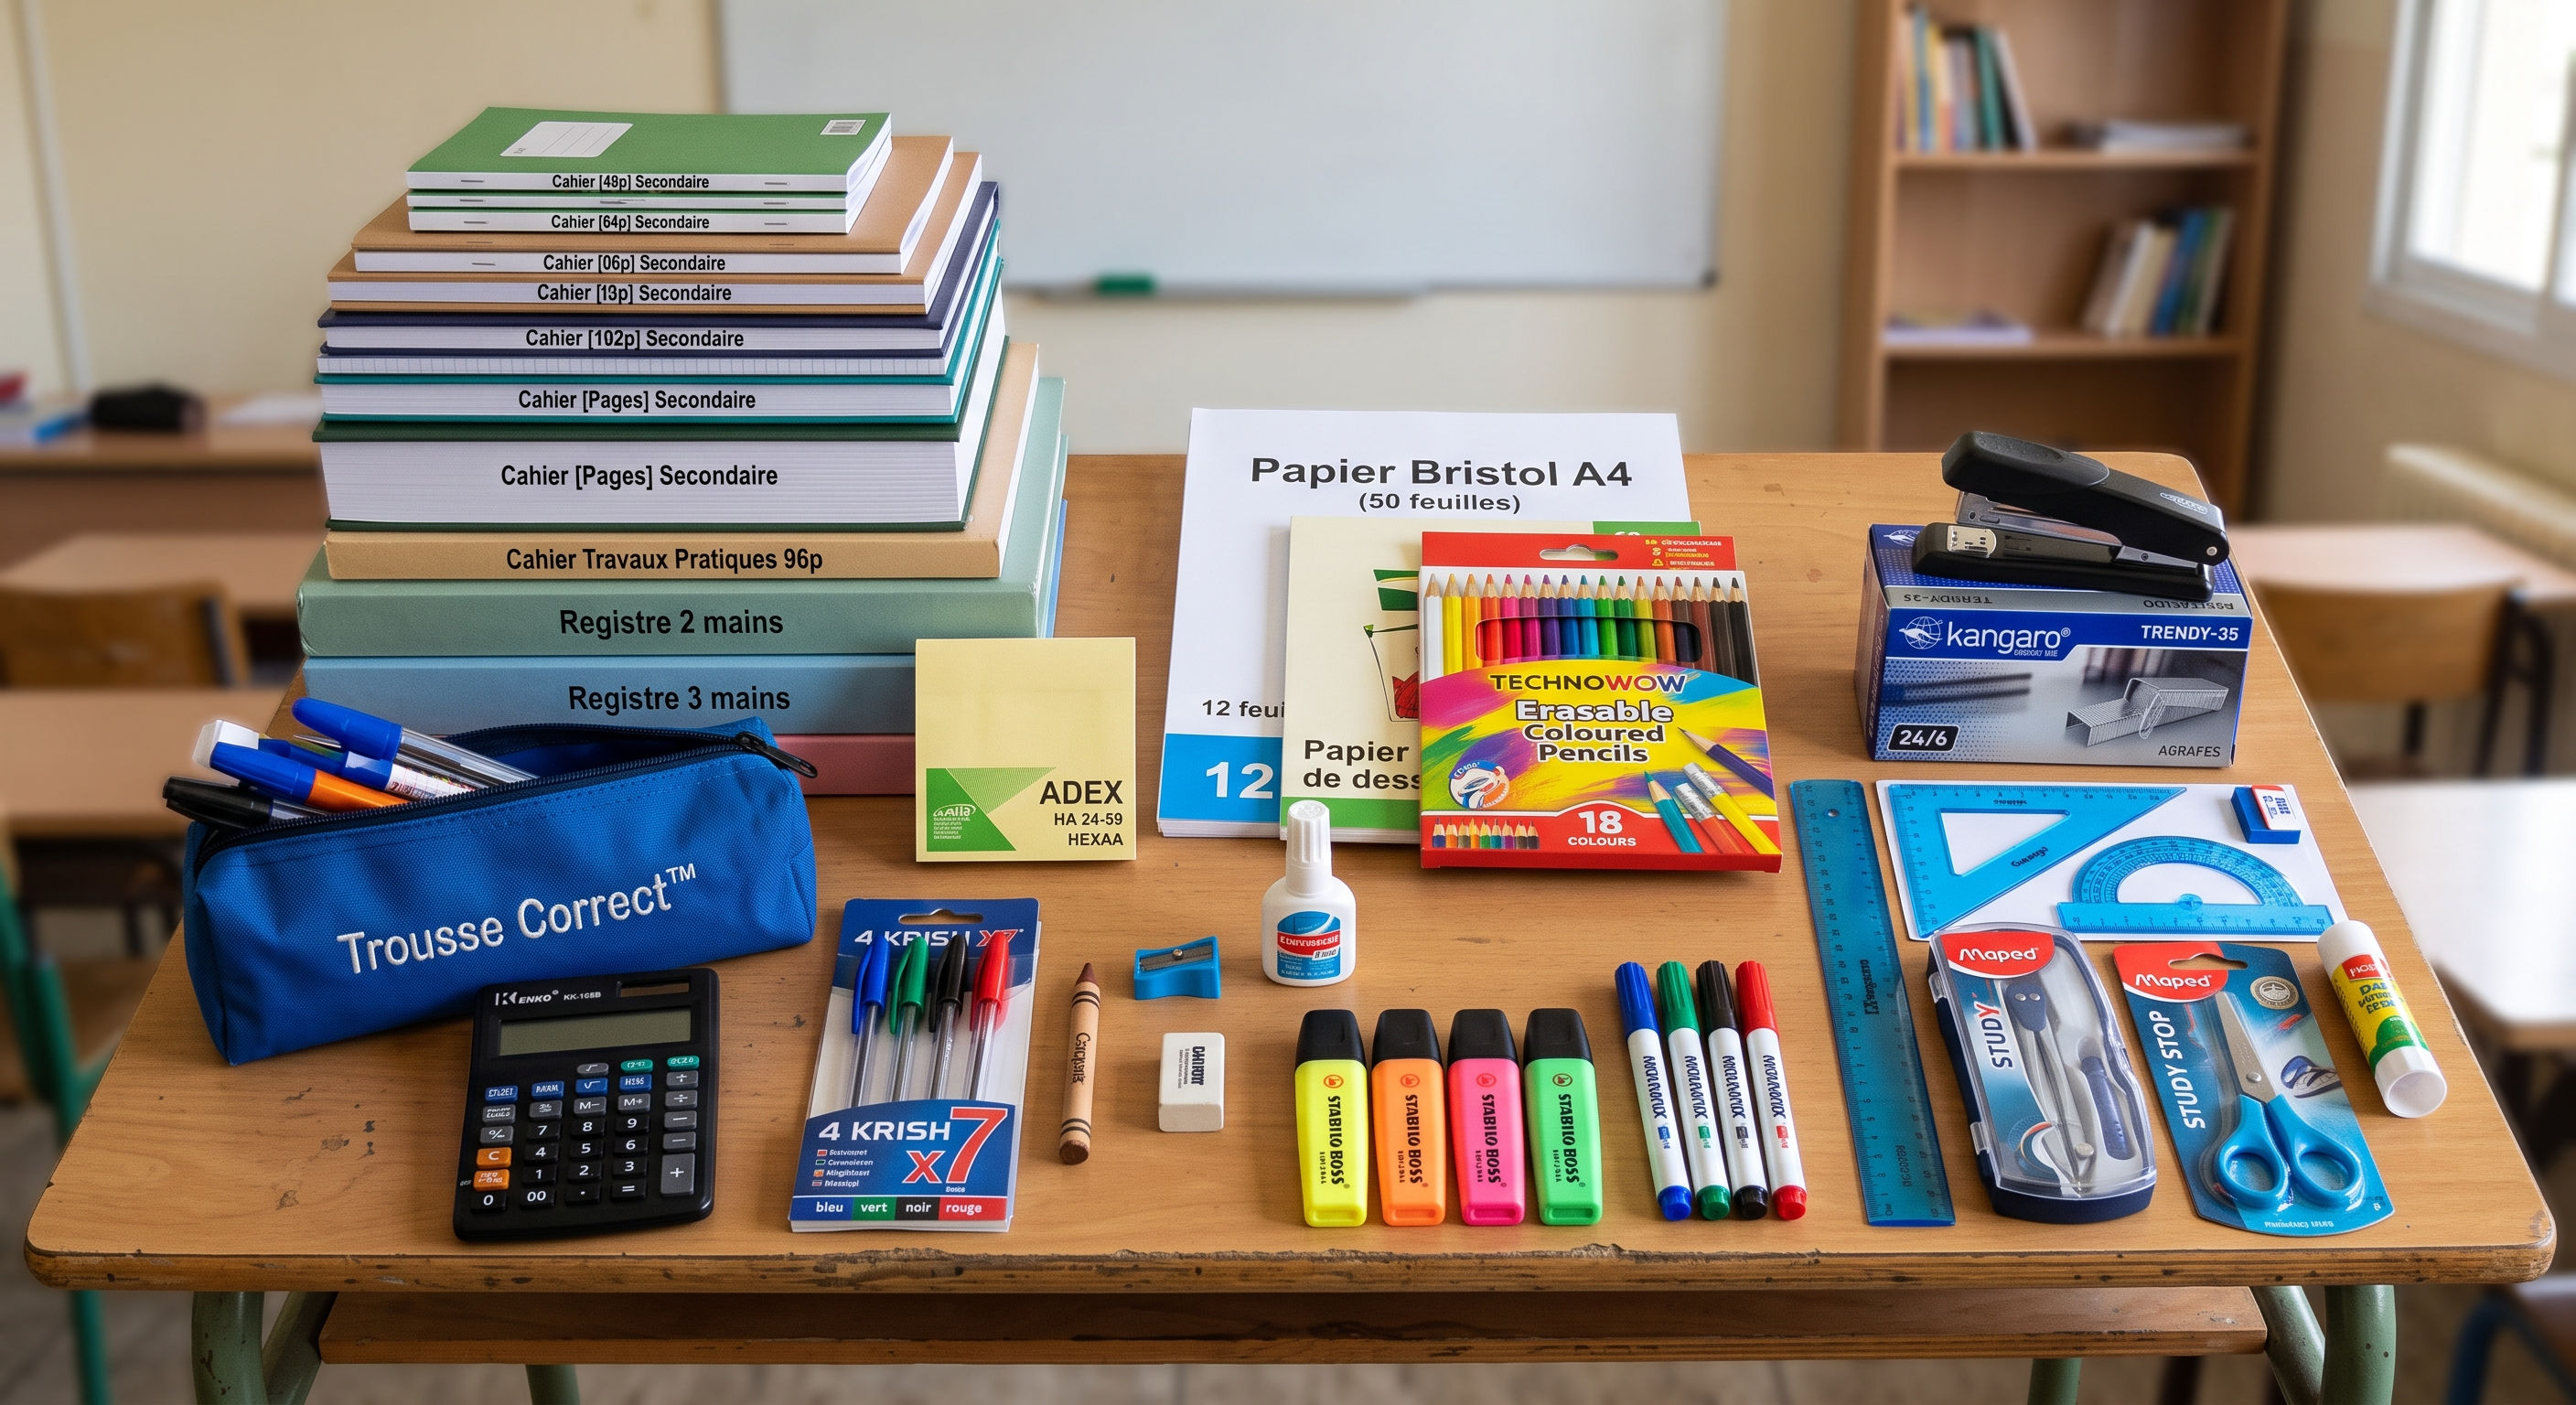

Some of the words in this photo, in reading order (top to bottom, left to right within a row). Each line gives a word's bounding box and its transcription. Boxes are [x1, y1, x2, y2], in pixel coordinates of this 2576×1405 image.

[553, 175, 595, 188] Cahier
[636, 175, 709, 188] Secondaire
[552, 215, 595, 229] Cahier
[598, 215, 630, 231] [64p]
[635, 215, 709, 229] Secondaire
[543, 254, 593, 270] Cahier
[598, 254, 635, 273] [06p]
[640, 254, 725, 270] Secondaire
[537, 284, 591, 300] Cahier
[639, 284, 732, 301] Secondaire
[525, 329, 584, 348] Cahier
[588, 329, 641, 351] [102p]
[646, 329, 745, 348] Secondaire
[518, 391, 578, 410] Cahier
[583, 391, 649, 413] [Pages]
[654, 391, 756, 410] Secondaire
[500, 465, 570, 487] Cahier
[576, 465, 653, 490] [Pages]
[660, 465, 778, 487] Secondaire
[1251, 457, 1396, 488] Papier
[1411, 459, 1557, 487] Bristol
[1572, 461, 1632, 487] A4
[1358, 492, 1401, 512] (50
[1410, 494, 1521, 514] feuilles)
[507, 549, 577, 570] Cahier
[583, 549, 669, 570] Travaux
[675, 549, 778, 575] Pratiques
[784, 549, 823, 575] 96p
[560, 609, 671, 639] Registre
[680, 609, 696, 634] 2
[703, 609, 783, 634] mains
[2141, 625, 2239, 641] TRENDY-35
[1947, 621, 2061, 658] kangaro
[1489, 674, 1686, 692] TECHNOWOW
[569, 686, 679, 716] Registre
[688, 686, 703, 711] 3
[711, 686, 790, 711] mains
[1203, 700, 1230, 715] 12
[1515, 700, 1674, 723] Erasable
[1524, 724, 1665, 743] Coloured
[1899, 730, 1948, 747] 24/6
[1304, 740, 1409, 766] Papier
[1538, 744, 1649, 762] Pencils
[2158, 745, 2221, 757] AGRAFES
[1206, 761, 1273, 799] 12
[1304, 768, 1341, 788] de
[1039, 780, 1123, 805] ADEX
[1054, 813, 1077, 825] HA
[1081, 812, 1123, 826] 24-59
[1578, 810, 1623, 834] 18
[1068, 833, 1123, 846] HEXAA
[1567, 836, 1637, 847] COLOURS
[337, 917, 503, 973] Trousse
[1959, 948, 2037, 962] Maped
[2135, 974, 2210, 990] Maped
[1975, 1003, 2012, 1068] STUDY
[2149, 1010, 2183, 1059] STOP
[2165, 1064, 2206, 1129] STUDY
[583, 1121, 593, 1132] 8
[628, 1119, 637, 1128] 9
[1327, 1095, 1342, 1148] STABILO
[1405, 1094, 1421, 1146] STABILO
[1482, 1094, 1498, 1145] STABILO
[1559, 1094, 1575, 1145] STABILO
[537, 1125, 547, 1135] 7
[819, 1121, 841, 1141] 4
[851, 1121, 950, 1141] KRISH
[535, 1147, 546, 1157] 4
[581, 1143, 591, 1153] 5
[626, 1140, 636, 1150] 6
[488, 1151, 499, 1161] C
[535, 1170, 542, 1179] 1
[579, 1165, 589, 1175] 2
[625, 1161, 635, 1171] 3
[1330, 1150, 1345, 1185] BOSS
[1408, 1150, 1423, 1184] BOSS
[1486, 1149, 1501, 1184] BOSS
[1563, 1149, 1579, 1183] BOSS
[483, 1195, 494, 1206] 0
[527, 1191, 546, 1202] 00
[816, 1202, 843, 1212] bleu
[861, 1203, 887, 1212] vert
[906, 1202, 931, 1213] noir
[946, 1204, 982, 1215] rouge
